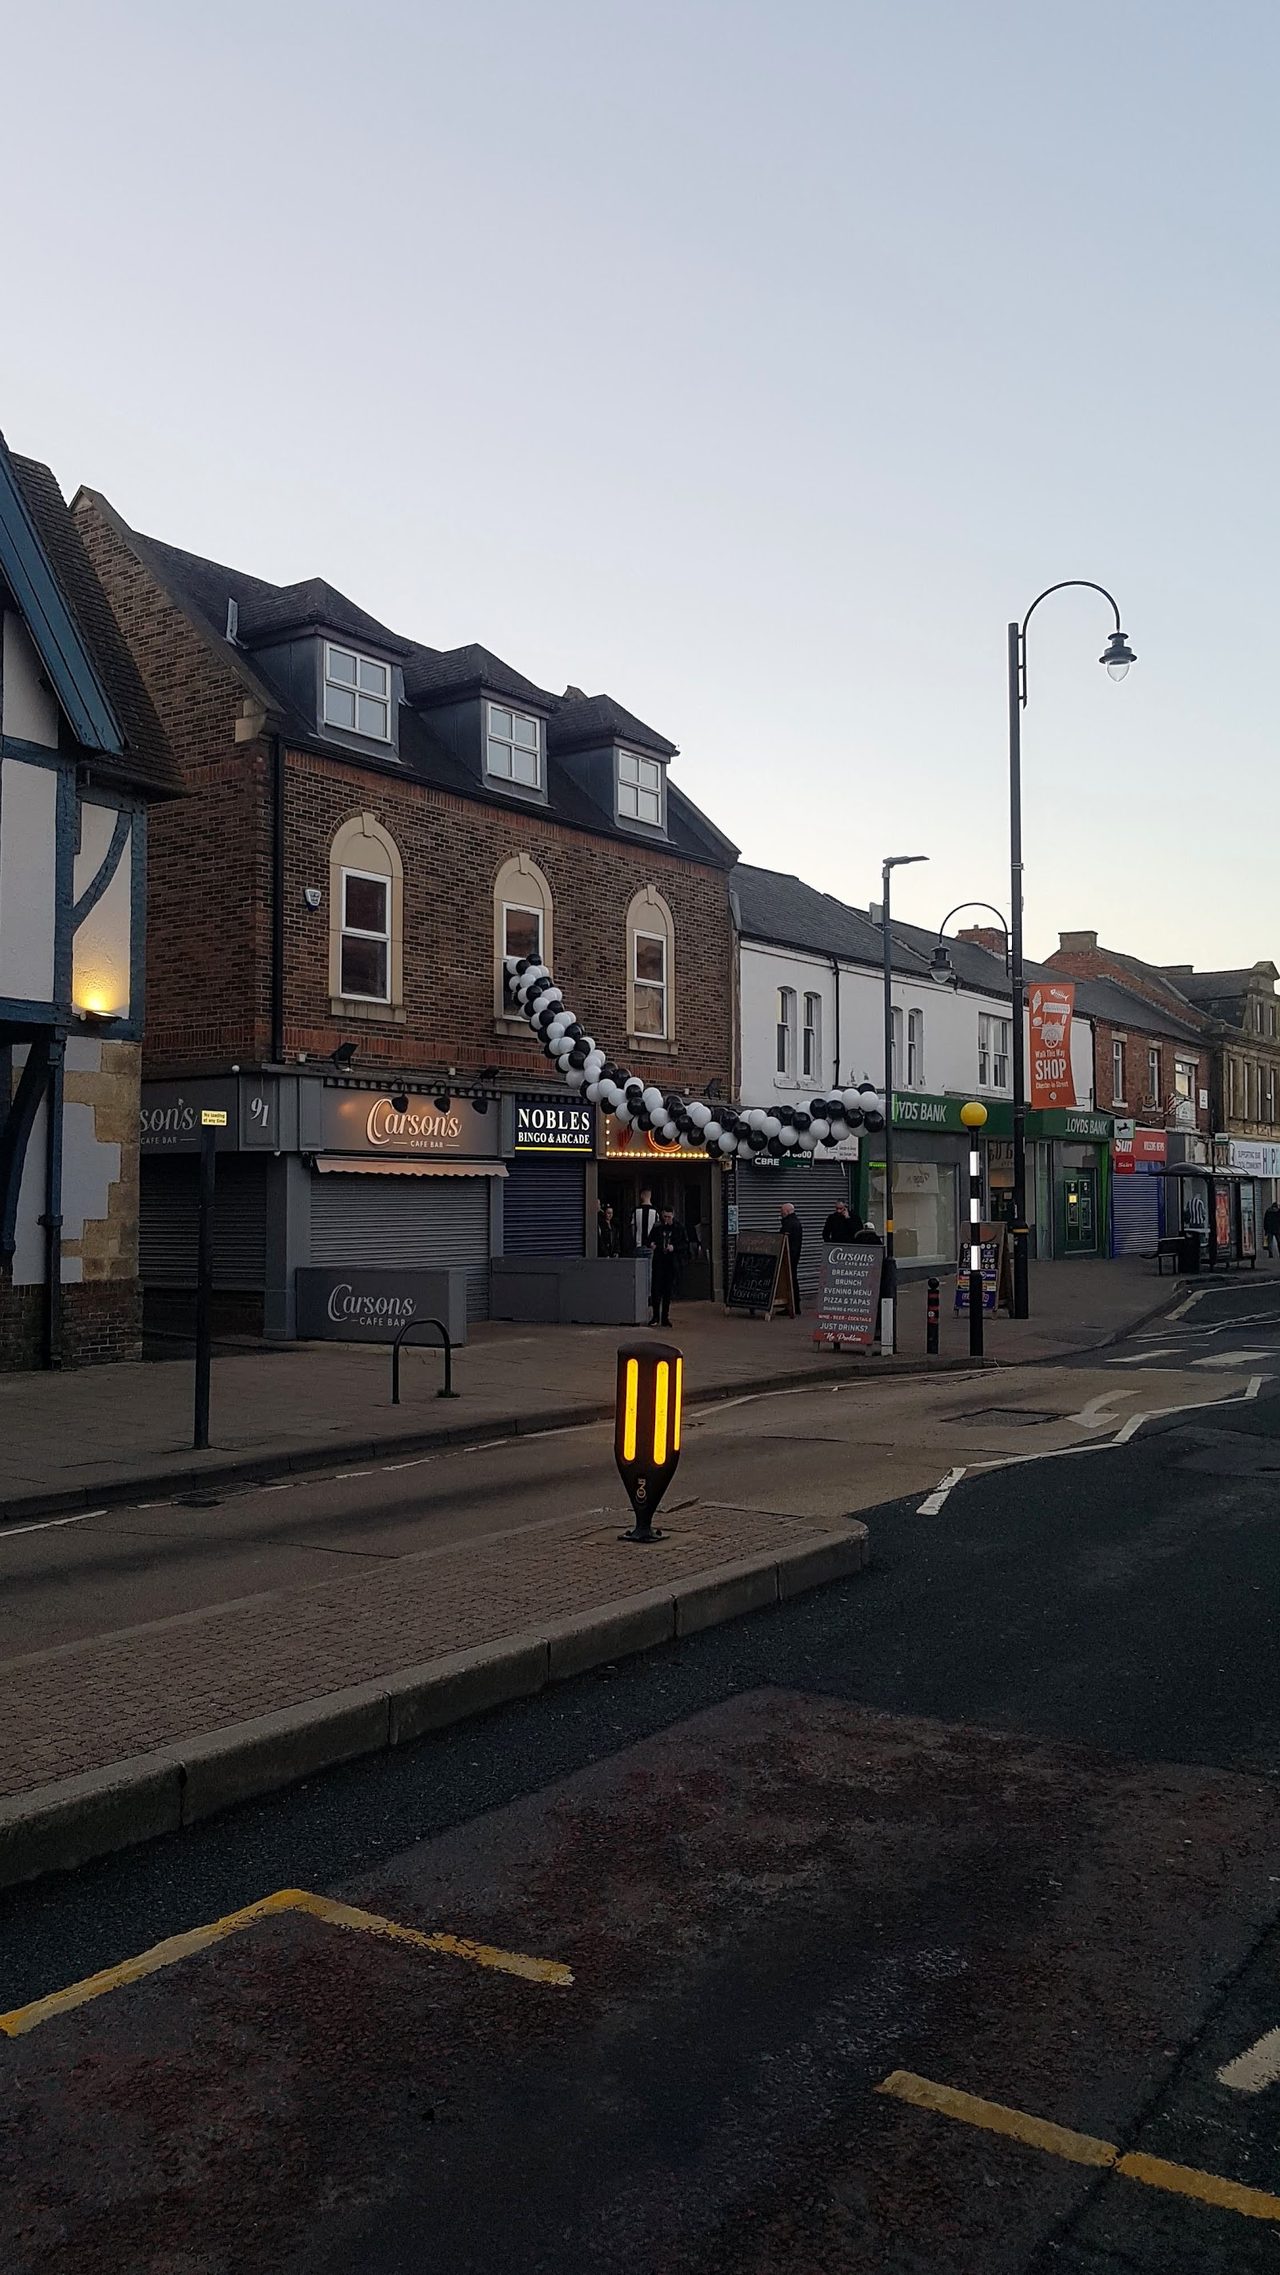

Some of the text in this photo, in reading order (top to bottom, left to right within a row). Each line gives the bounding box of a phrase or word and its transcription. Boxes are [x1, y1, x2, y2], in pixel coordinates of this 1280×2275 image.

[1036, 1058, 1066, 1080] SHOP
[250, 1097, 269, 1127] 91
[518, 1108, 590, 1130] NOBLES
[920, 1103, 946, 1122] BANK
[1089, 1120, 1107, 1134] BANK
[518, 1132, 590, 1144] BINGO & ARCADE
[754, 1158, 780, 1166] CBRE
[828, 1247, 874, 1264] Carsons
[328, 1284, 416, 1322] Carsons
[360, 1317, 406, 1327] CAFE BAR
